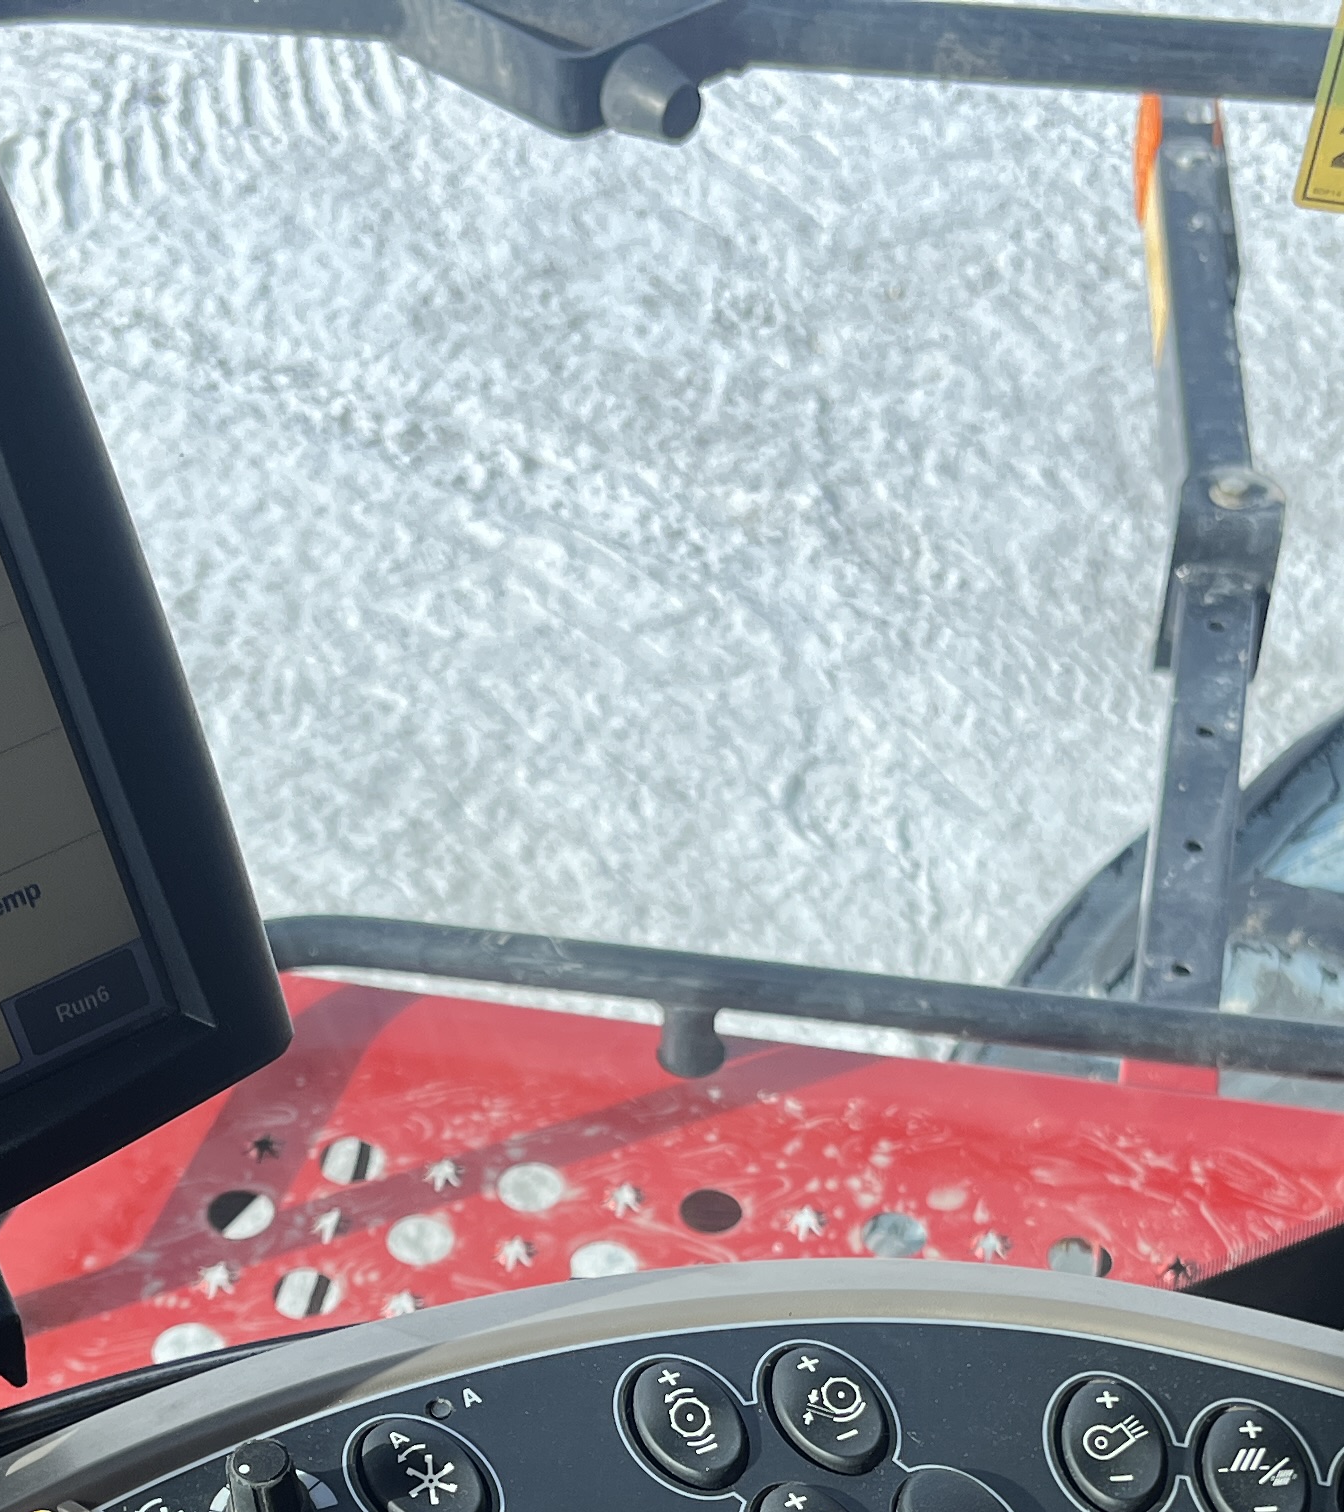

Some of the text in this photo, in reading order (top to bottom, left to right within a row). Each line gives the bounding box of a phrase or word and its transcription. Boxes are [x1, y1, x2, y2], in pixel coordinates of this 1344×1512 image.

[55, 986, 111, 1023] Run6
[462, 1387, 483, 1408] A
[389, 1430, 408, 1450] A
